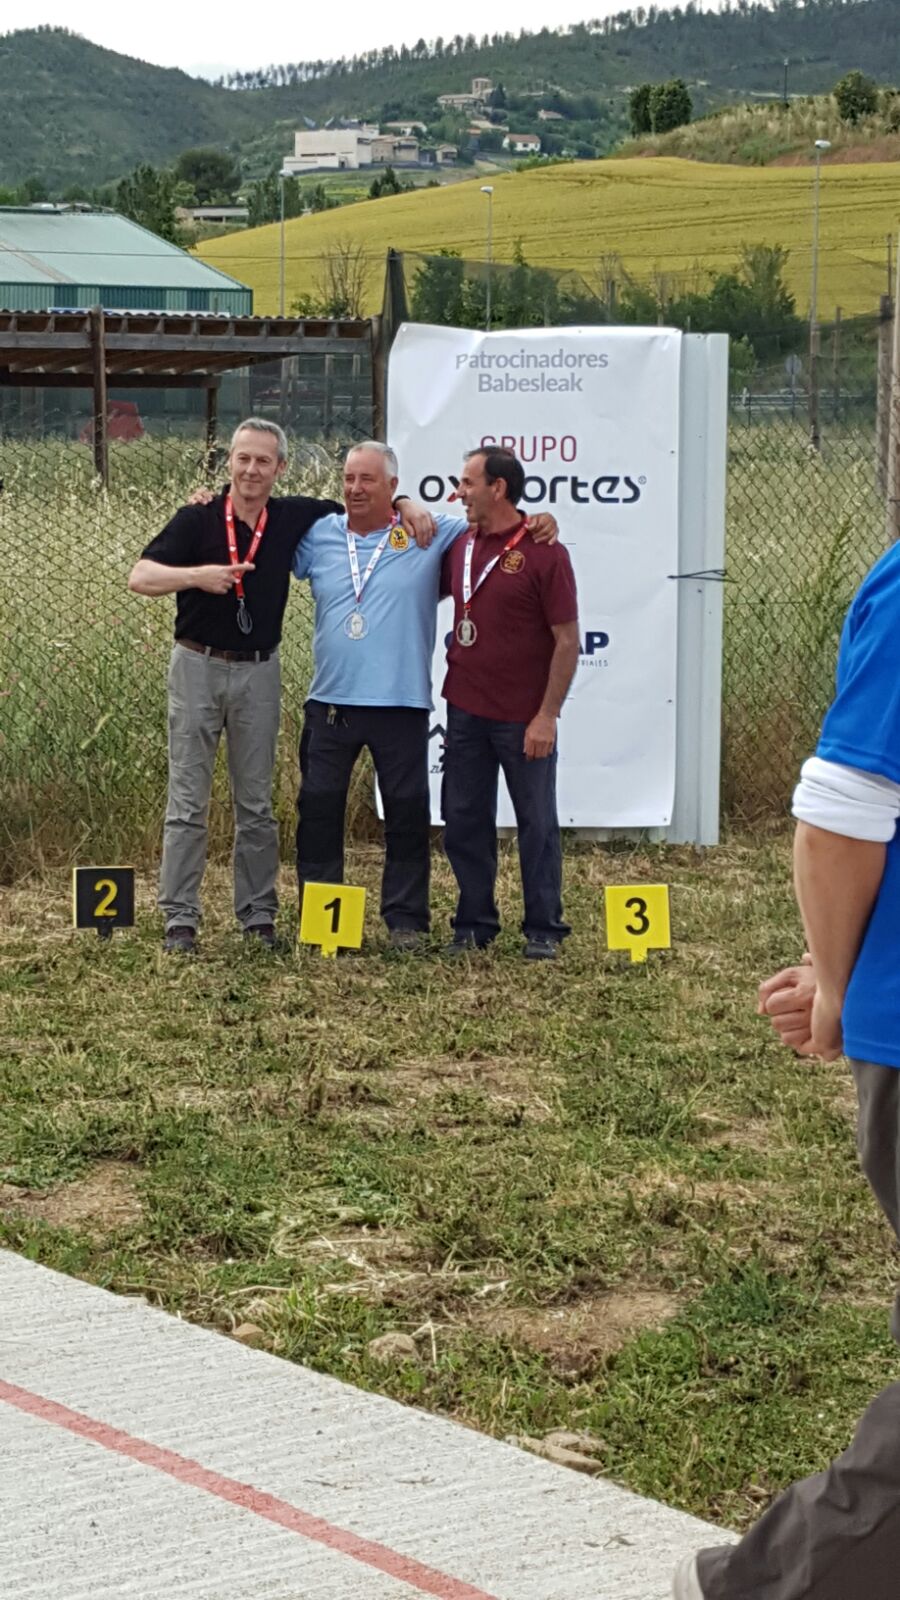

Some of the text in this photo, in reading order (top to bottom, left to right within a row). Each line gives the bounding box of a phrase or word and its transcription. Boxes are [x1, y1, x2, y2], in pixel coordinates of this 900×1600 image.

[455, 349, 609, 370] Patrocinadores
[478, 372, 583, 392] Babesleak
[93, 878, 118, 917] 2
[324, 897, 342, 934] 1
[625, 897, 650, 936] 3
